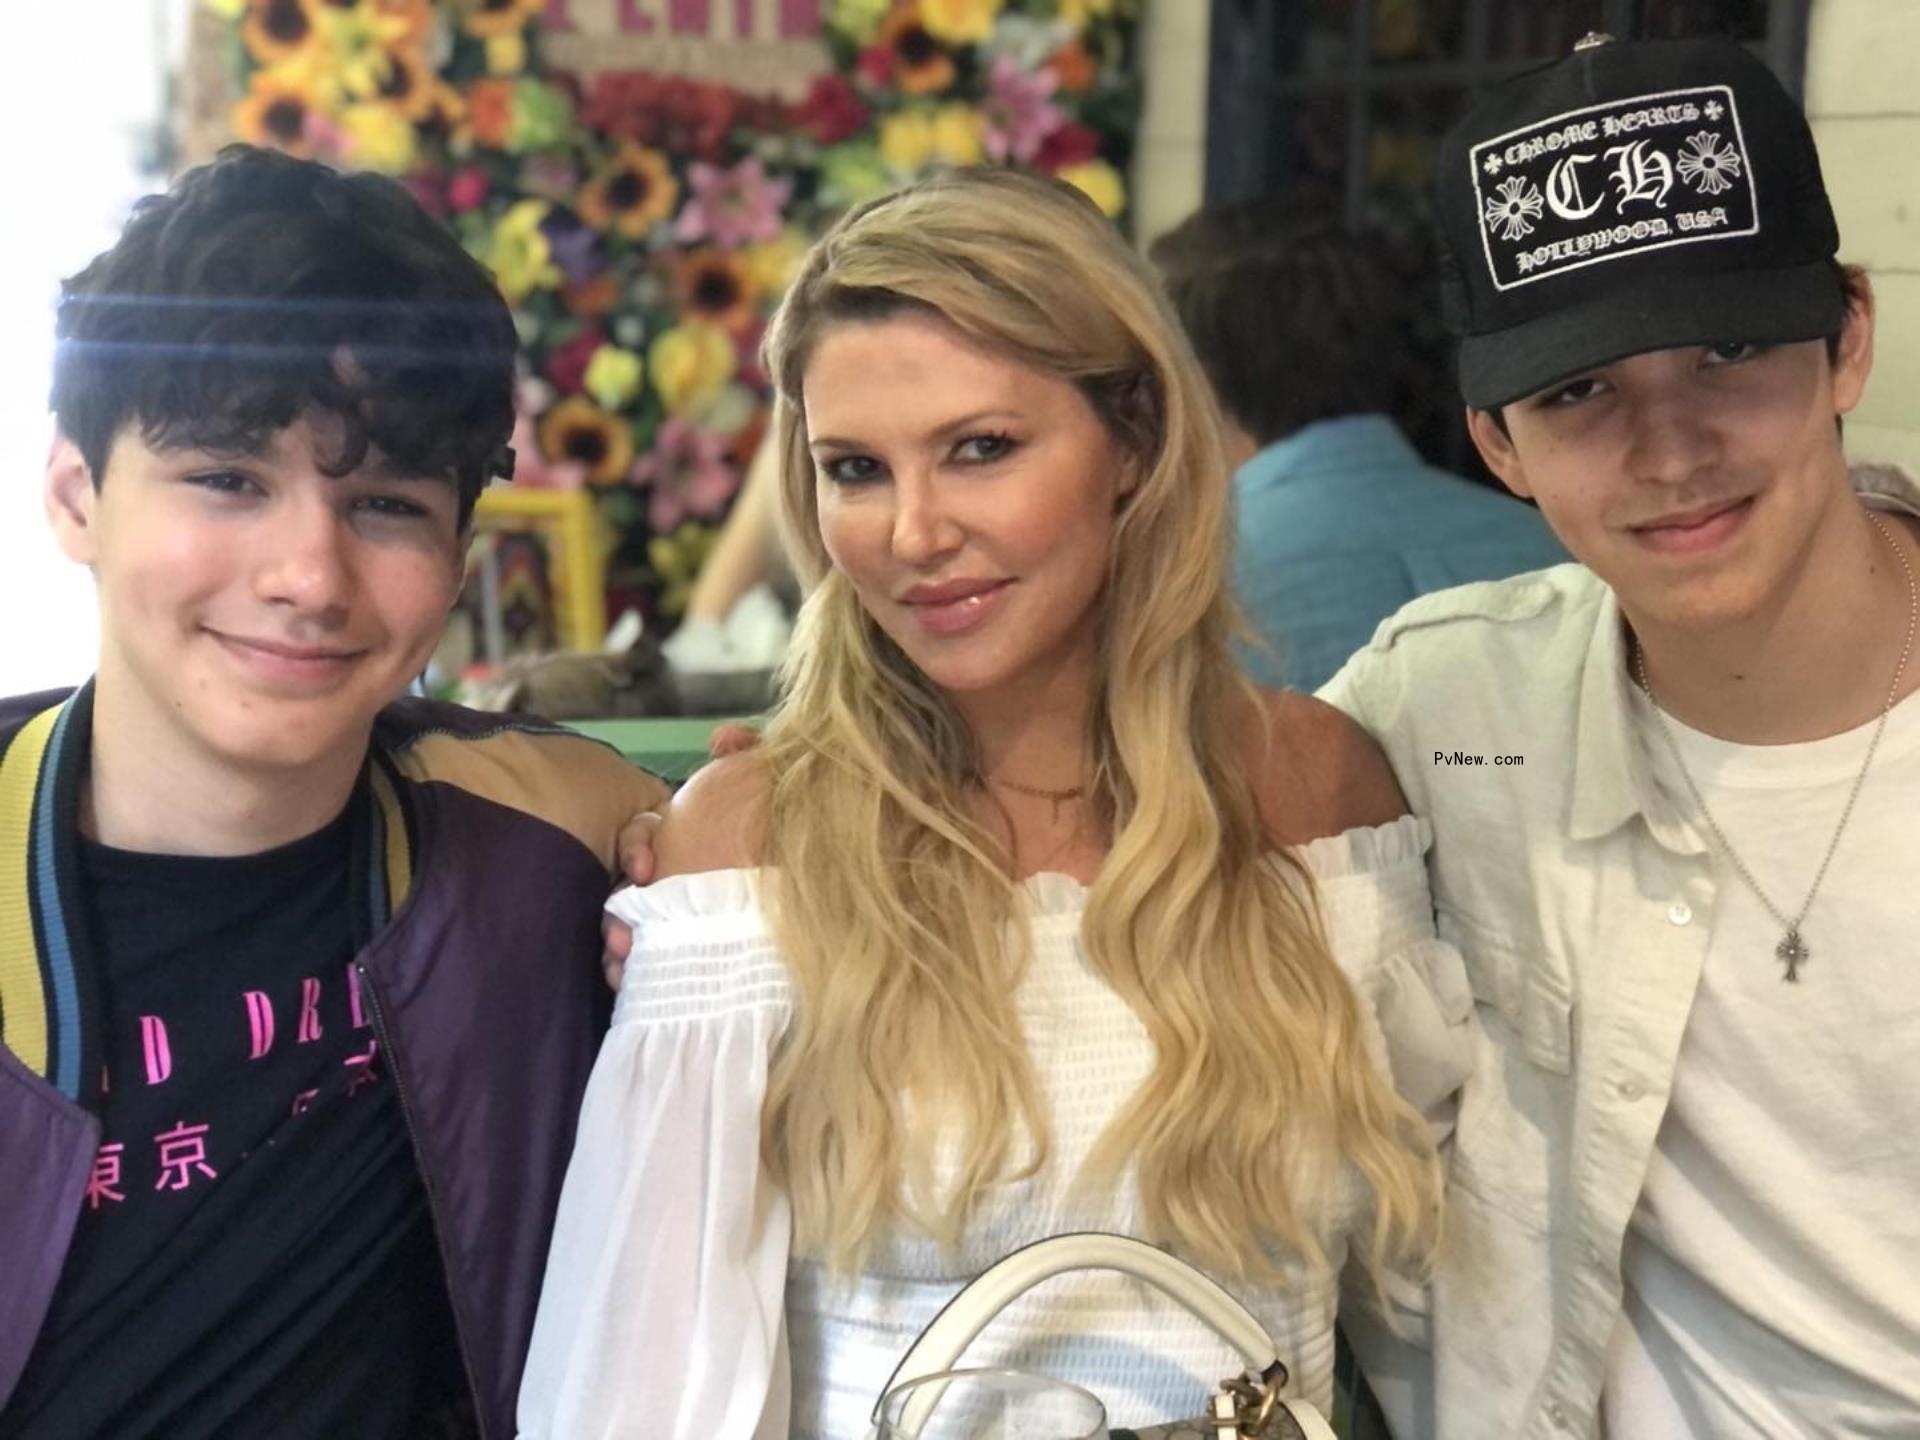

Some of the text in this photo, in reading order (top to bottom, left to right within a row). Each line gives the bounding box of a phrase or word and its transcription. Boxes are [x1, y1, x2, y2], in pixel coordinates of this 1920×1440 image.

[1504, 102, 1701, 166] CHROME HEARTS
[1545, 138, 1675, 221] CH
[1515, 206, 1729, 275] HOLLYWOOD, USA
